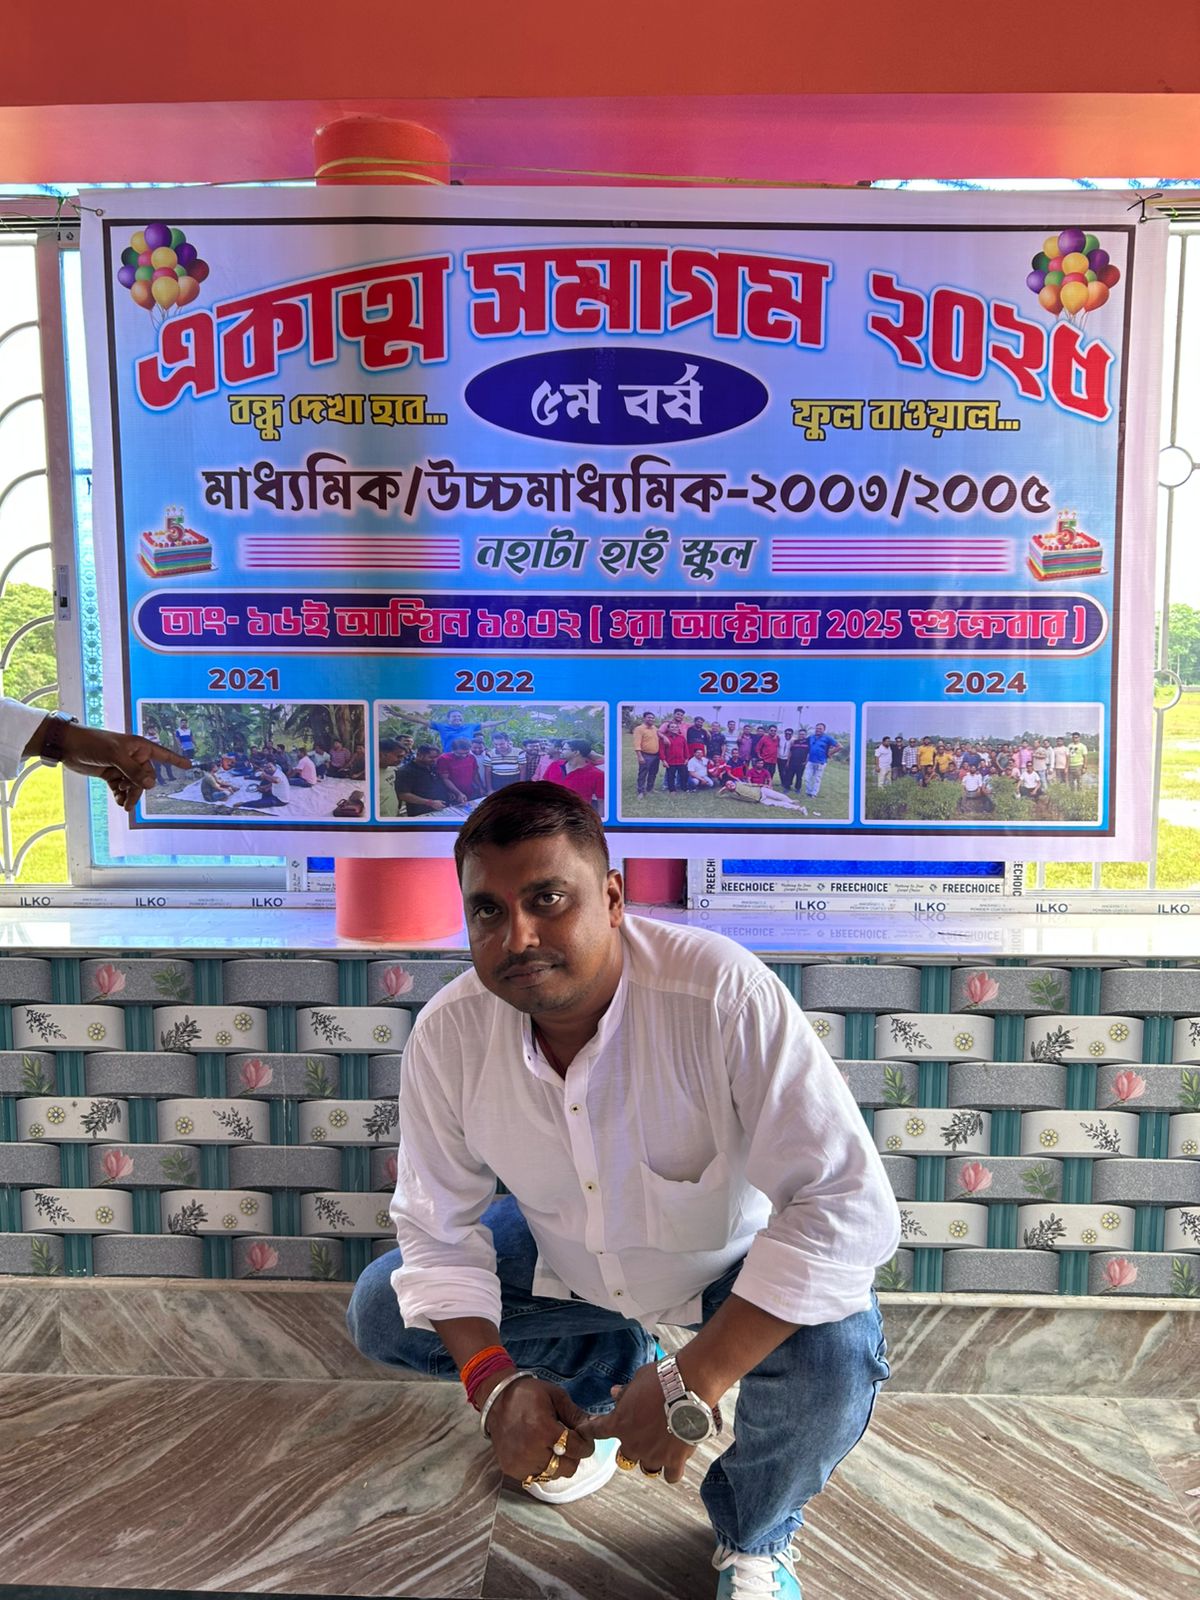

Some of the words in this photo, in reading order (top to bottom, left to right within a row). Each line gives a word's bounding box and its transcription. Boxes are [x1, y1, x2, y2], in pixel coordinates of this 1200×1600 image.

[465, 246, 831, 347] সমাগম
[869, 272, 1112, 420] ২০২৫
[531, 378, 601, 425] ৫ম
[618, 363, 703, 425] বর্ষ
[228, 395, 285, 441] বন্ধু
[290, 395, 366, 424] দেখা
[369, 395, 448, 427] হবে...
[792, 400, 865, 441] ফুল
[476, 528, 588, 574] নহাটা
[600, 529, 669, 574] হাই
[682, 539, 757, 580] স্কুল
[247, 600, 330, 638] ১৬ই
[334, 598, 471, 643] আশ্বিন
[477, 609, 580, 638] ১৪৩২
[670, 603, 821, 646] অক্টোবর
[826, 610, 901, 638] 2025
[908, 610, 1068, 645] শুক্রবার
[208, 667, 279, 690] 2021
[455, 670, 534, 693] 2022
[700, 671, 779, 694] 2023
[944, 671, 1027, 694] 2024
[830, 882, 888, 892] FREECHOICE
[942, 883, 1000, 893] FREECHOICE
[20, 896, 51, 907] ILKO
[135, 897, 166, 907] ILKO
[252, 897, 283, 907] ILKO
[794, 900, 827, 911] ILKO
[914, 902, 946, 912] ILKO
[1036, 903, 1068, 913] ILKO
[1158, 904, 1190, 914] ILKO
